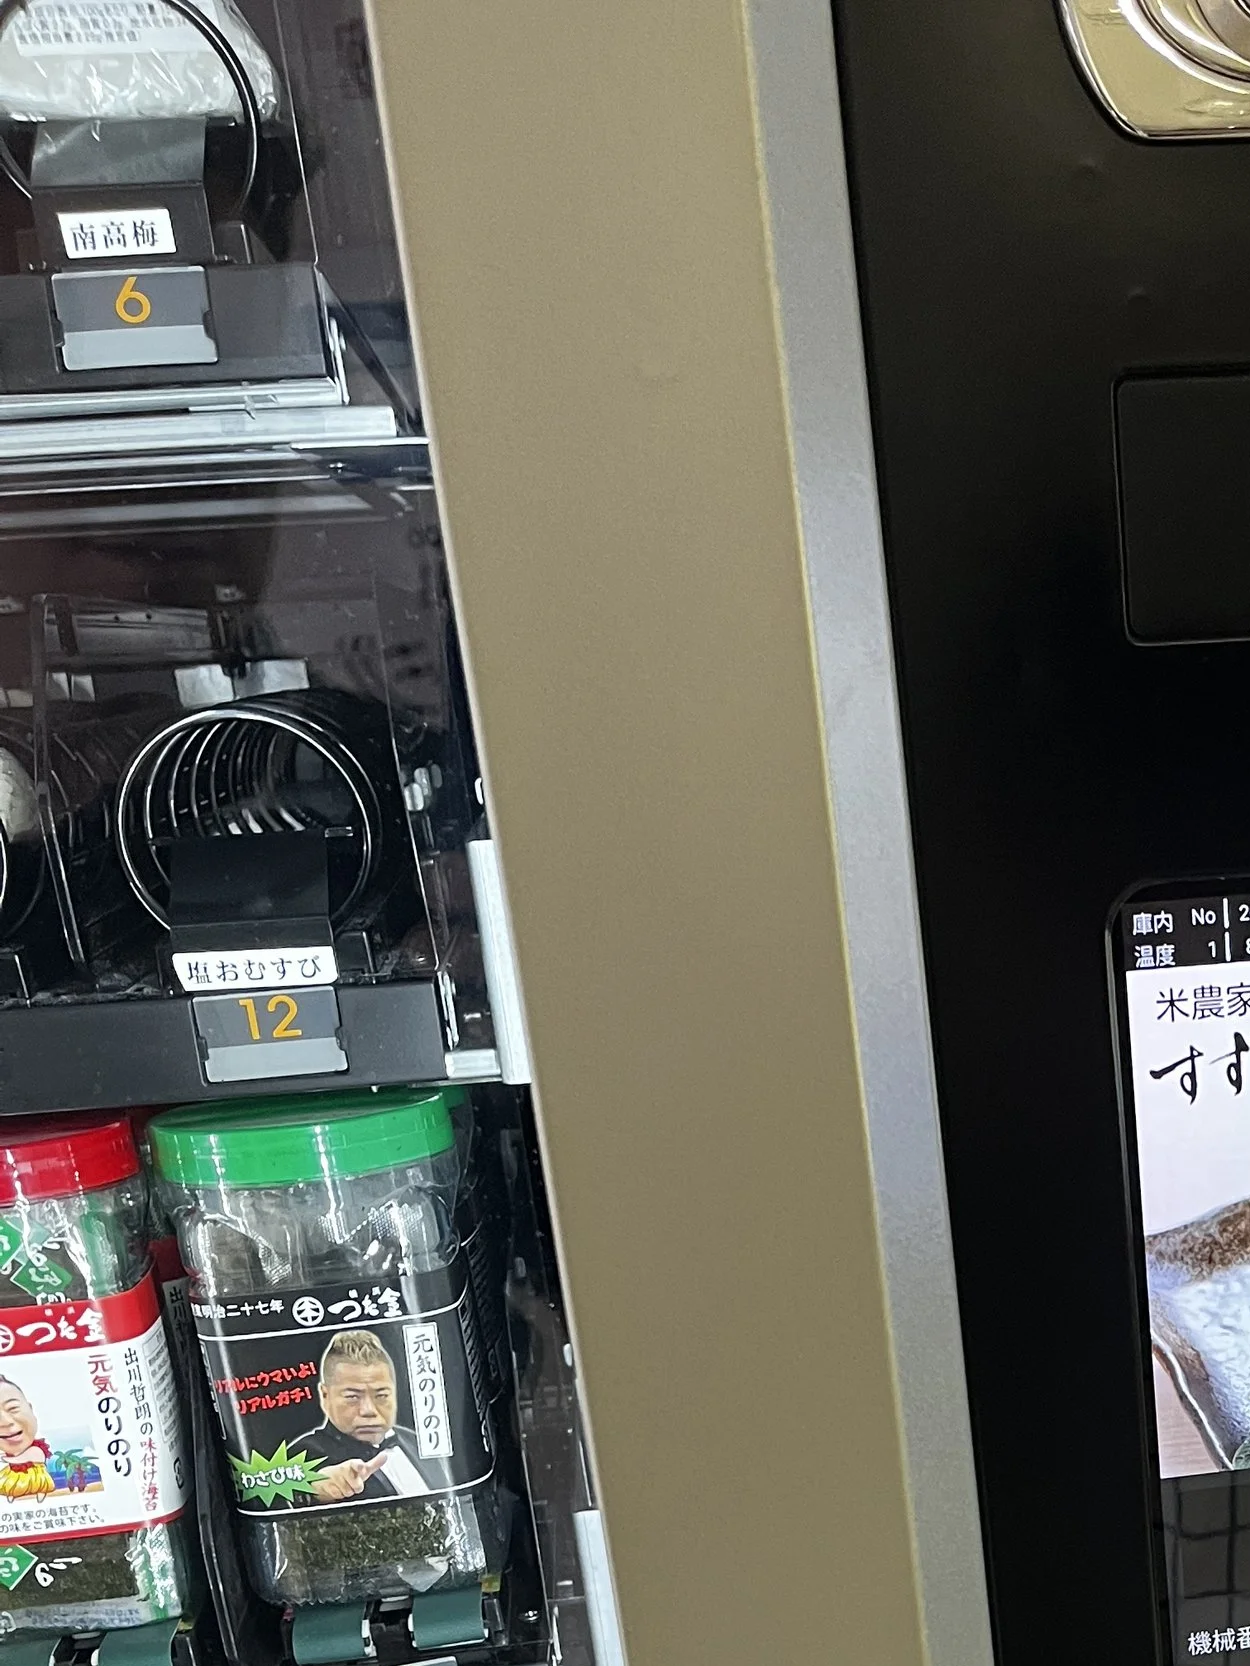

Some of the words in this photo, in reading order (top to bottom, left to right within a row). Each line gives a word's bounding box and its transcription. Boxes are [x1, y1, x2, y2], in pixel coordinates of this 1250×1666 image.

[69, 220, 159, 251] 南高梅
[115, 276, 152, 324] 6
[1132, 910, 1174, 936] 庫内
[1191, 907, 1217, 926] No
[186, 953, 323, 985] 塩おむすび
[1134, 943, 1176, 968] 温度
[1207, 940, 1217, 958] 1
[239, 994, 303, 1040] 12
[412, 1333, 442, 1450] 元気のりのり
[88, 1353, 132, 1477] 元気のりのり
[242, 1463, 306, 1489] わさび味
